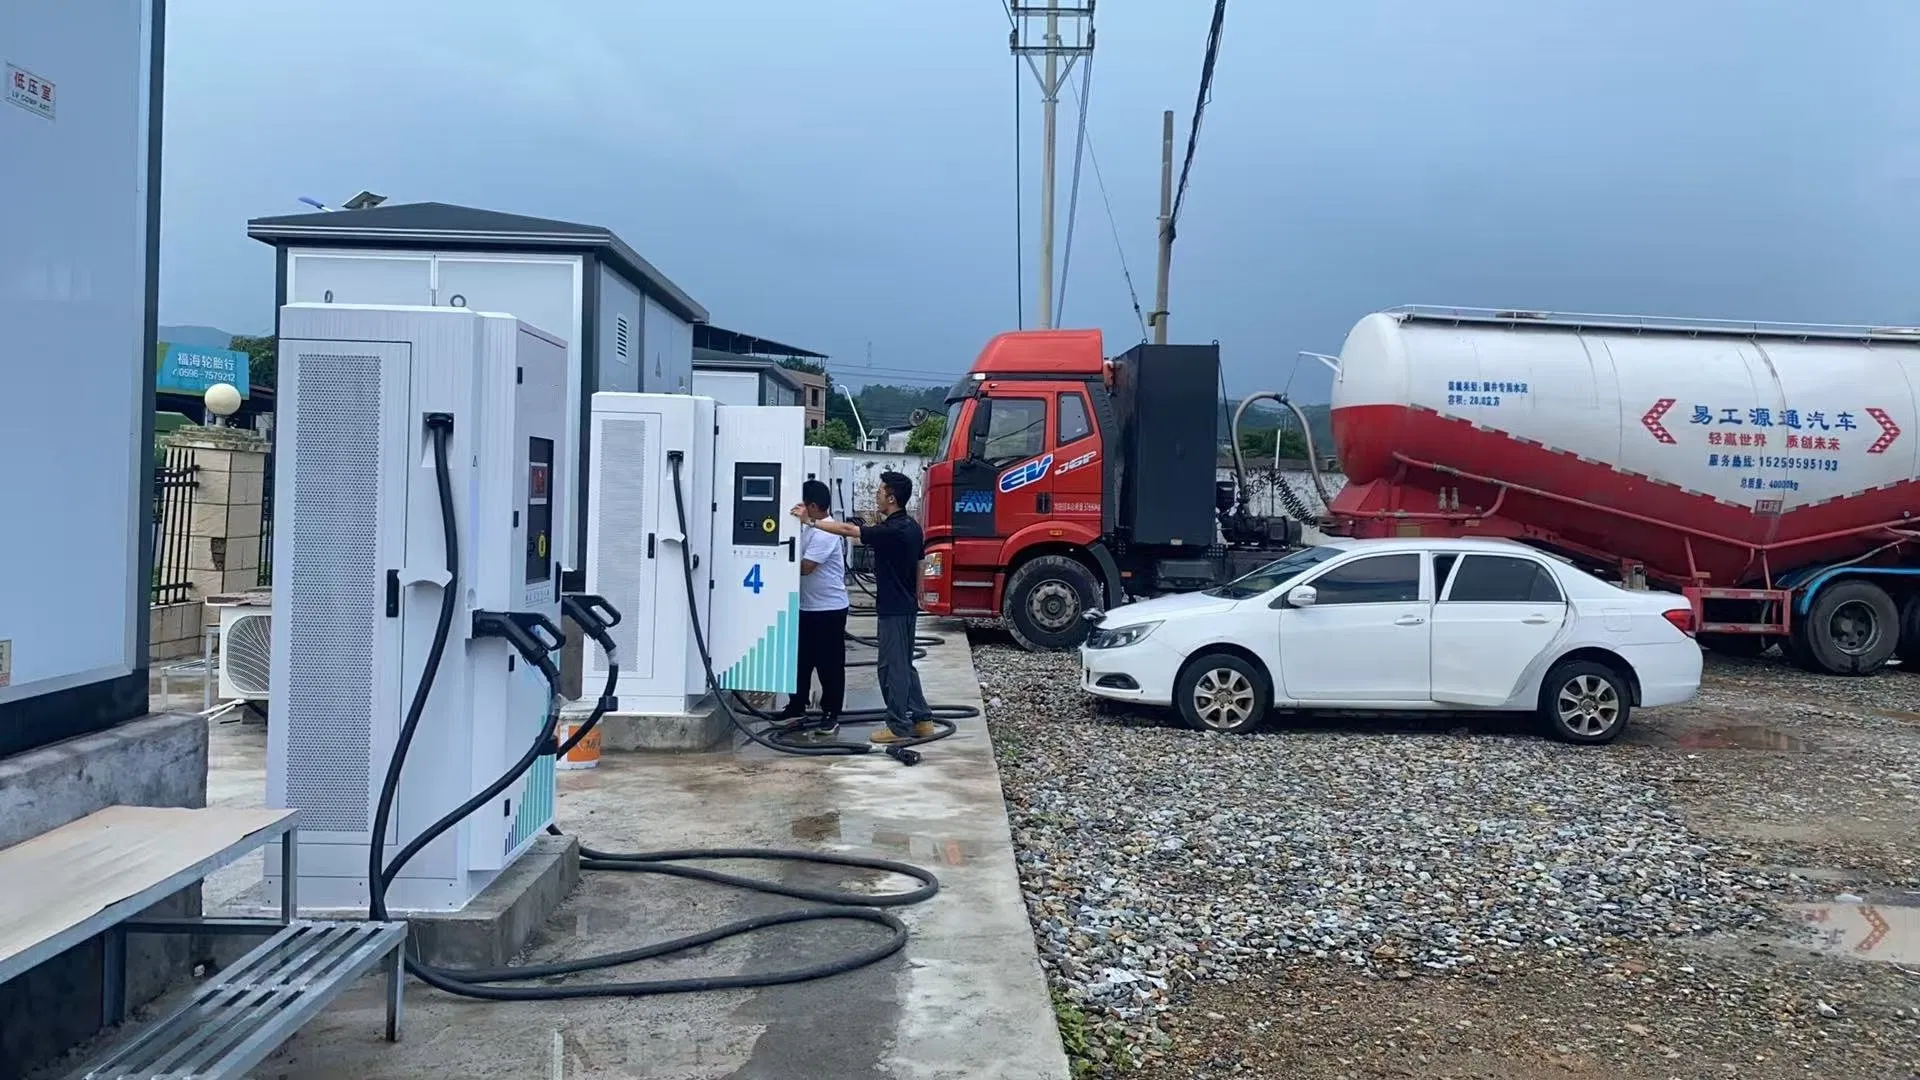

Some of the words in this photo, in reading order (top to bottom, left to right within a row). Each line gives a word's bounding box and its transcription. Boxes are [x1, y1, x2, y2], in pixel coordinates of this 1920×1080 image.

[14, 71, 51, 102] 低压室
[178, 352, 235, 371] 福海轮胎行
[179, 368, 236, 383] 0596-7579212
[1690, 405, 1857, 431] 易工源通汽车
[1708, 431, 1767, 447] 轻赢世界
[1785, 435, 1840, 450] 质创未来
[1000, 454, 1053, 493] EV
[955, 502, 992, 512] FAW
[743, 564, 764, 594] 4
